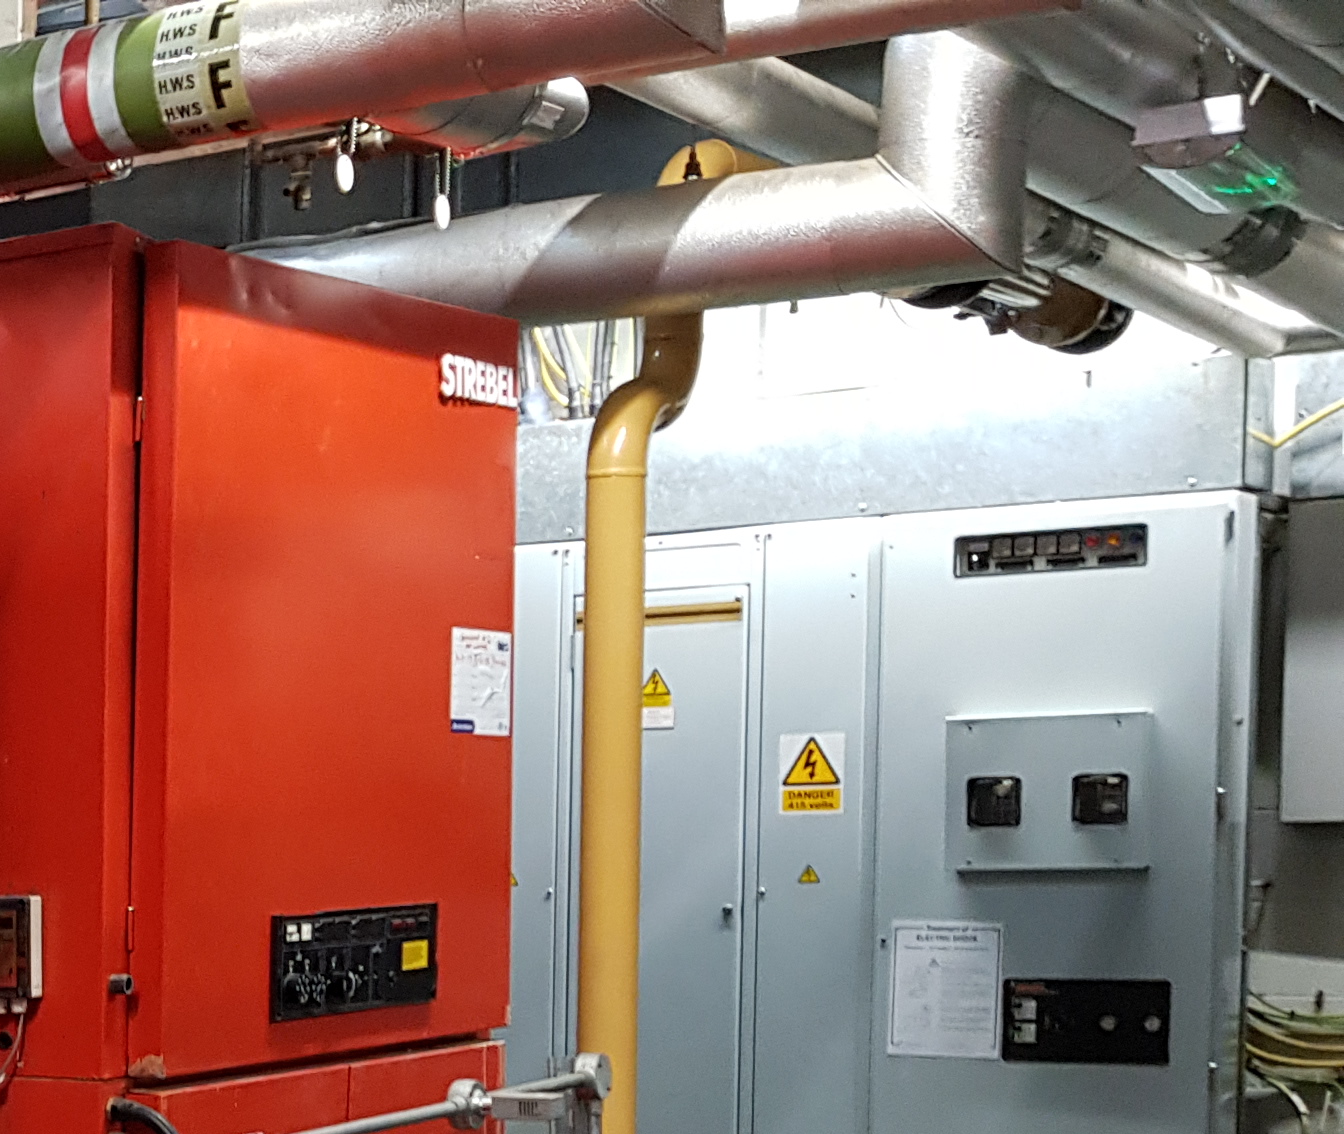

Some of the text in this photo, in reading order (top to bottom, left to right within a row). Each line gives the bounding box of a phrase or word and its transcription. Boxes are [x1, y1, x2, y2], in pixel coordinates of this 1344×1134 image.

[208, 0, 239, 41] F
[208, 58, 233, 110] F
[440, 353, 518, 408] STREBEL
